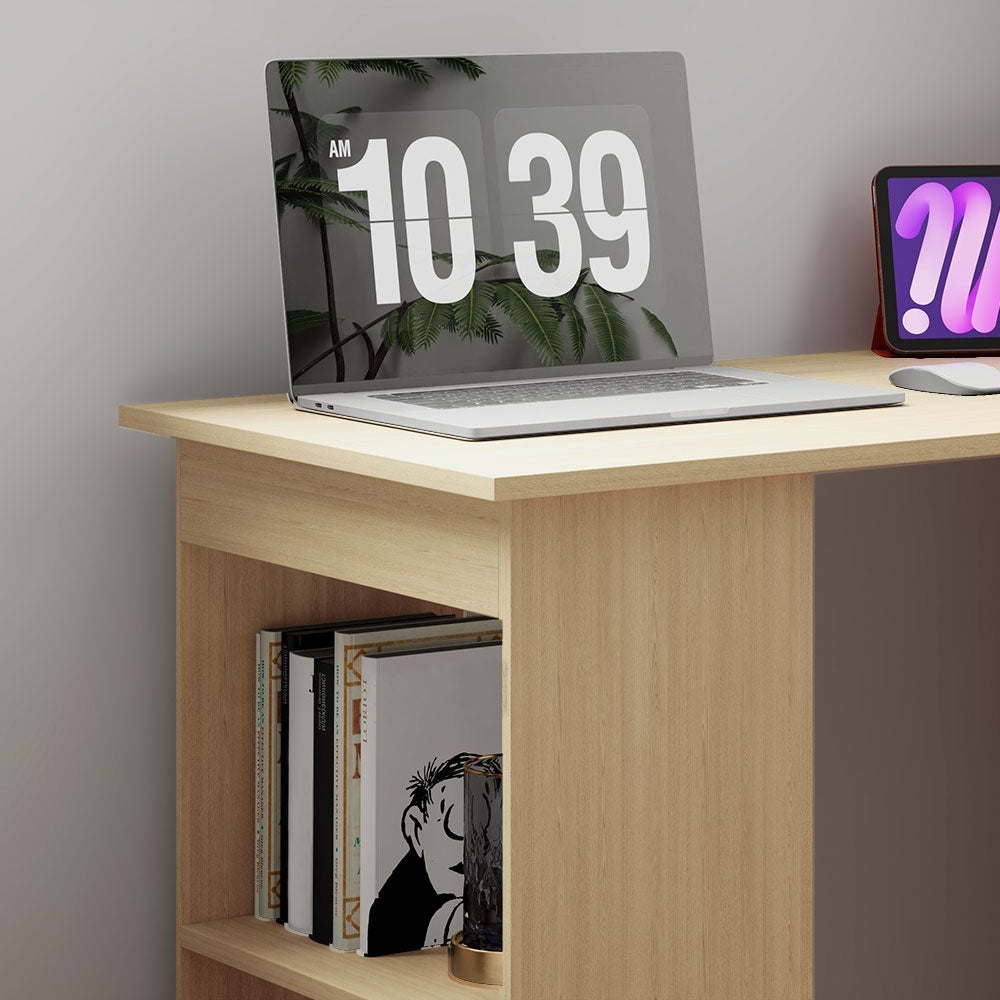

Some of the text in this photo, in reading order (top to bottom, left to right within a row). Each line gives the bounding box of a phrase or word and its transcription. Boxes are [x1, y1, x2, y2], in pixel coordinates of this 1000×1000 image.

[329, 139, 351, 159] AM
[336, 129, 651, 306] 10 39
